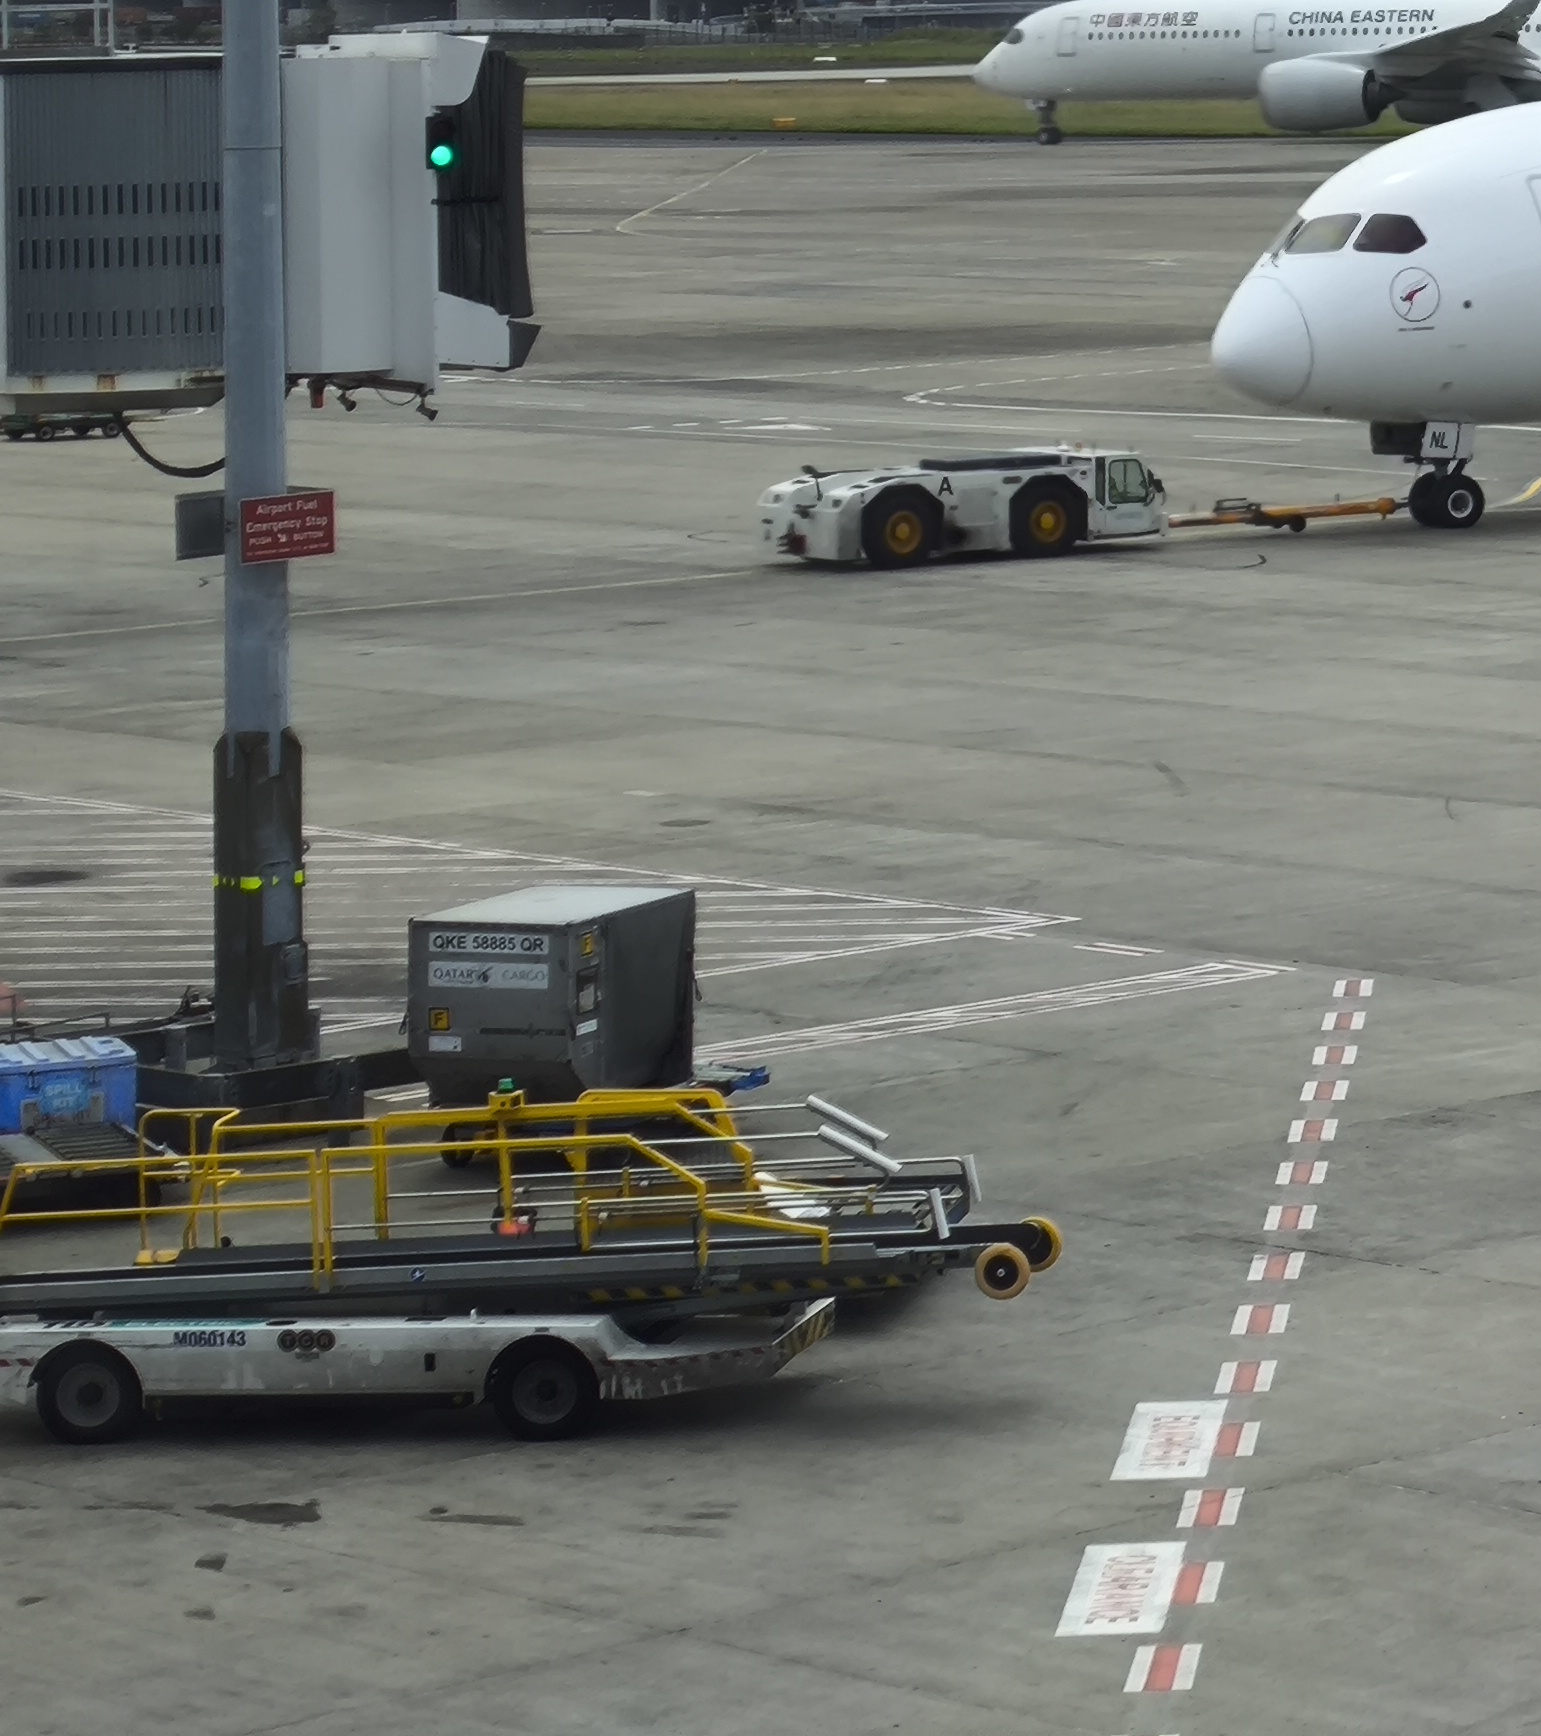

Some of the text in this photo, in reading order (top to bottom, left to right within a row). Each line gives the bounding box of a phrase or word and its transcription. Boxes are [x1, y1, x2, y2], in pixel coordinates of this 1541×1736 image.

[1288, 9, 1435, 25] CHINA EASTERN
[1429, 430, 1448, 449] NL
[938, 476, 953, 496] A
[256, 499, 317, 516] Airport Fuel
[246, 515, 328, 533] Emergency Stop
[432, 935, 544, 952] QKE 58885 QR
[433, 967, 546, 982] QATAR CARGO
[434, 1012, 445, 1026] F
[173, 1330, 247, 1348] M060143
